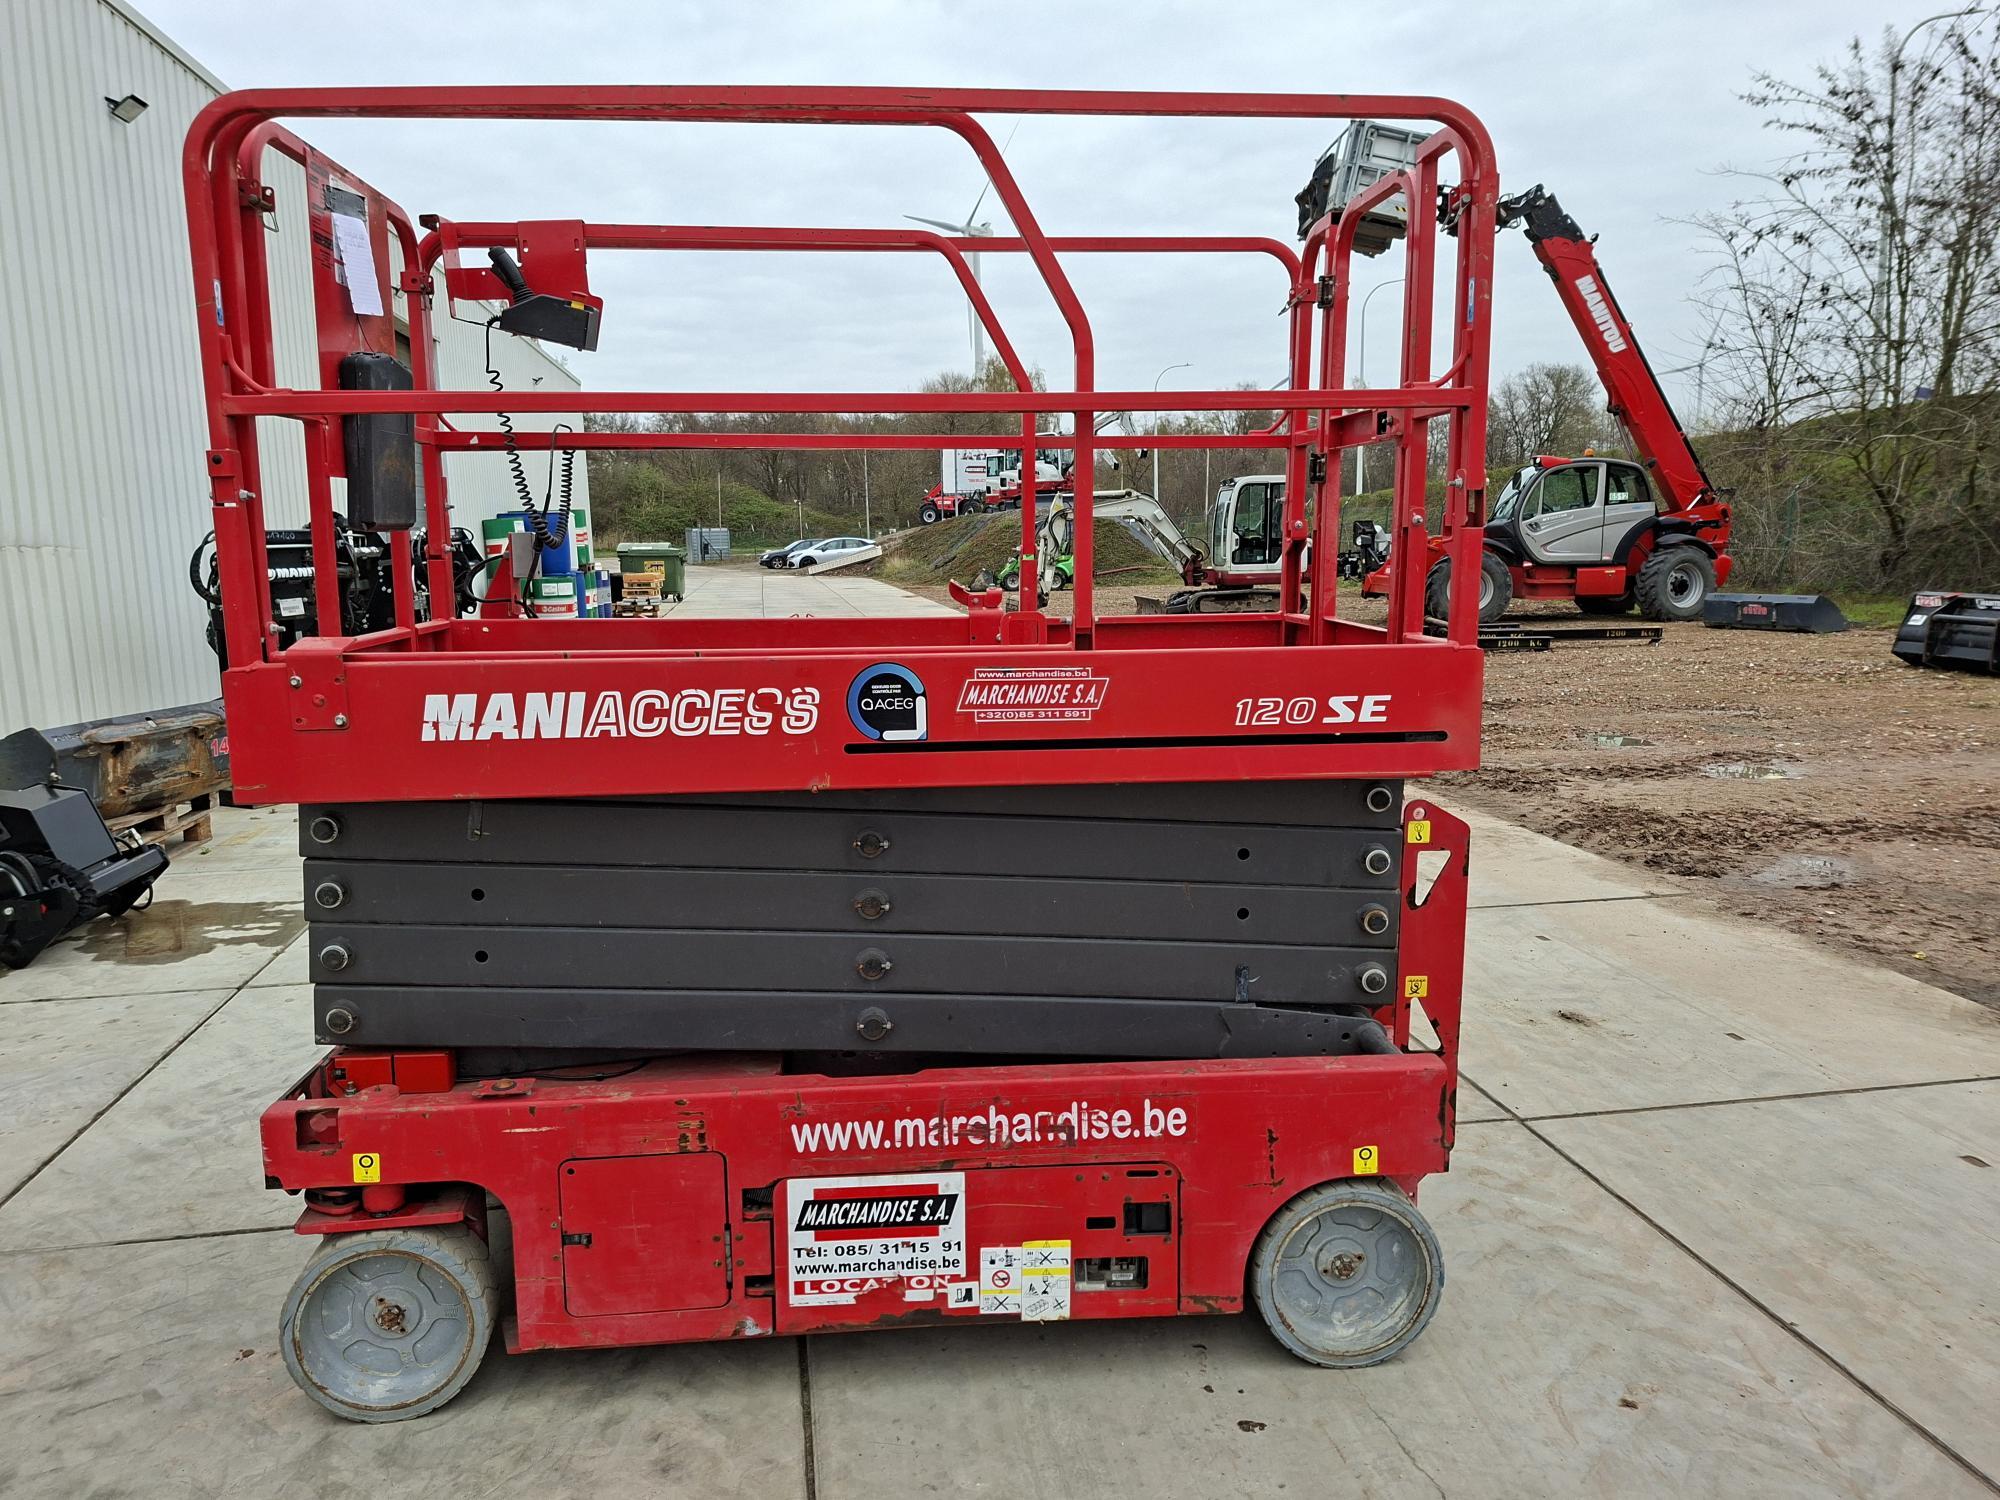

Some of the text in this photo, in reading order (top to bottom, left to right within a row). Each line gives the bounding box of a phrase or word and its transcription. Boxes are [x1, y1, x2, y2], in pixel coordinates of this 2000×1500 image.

[1575, 274, 1628, 353] MANITOU
[978, 669, 1088, 679] www.marchandise.be
[965, 683, 1099, 705] MARCHANDISE S.A.
[421, 687, 820, 742] MANIACCESS
[979, 710, 1087, 720] +32(0)85 311 591
[1235, 695, 1392, 726] 120 SE
[791, 1099, 1187, 1153] www.marchandise.be
[801, 1199, 950, 1226] MARCHANDISE S.A.
[835, 1244, 873, 1257] 085/
[880, 1243, 900, 1255] 31
[941, 1240, 962, 1252] 91
[795, 1255, 961, 1275] www.marchandise.be
[804, 1275, 951, 1294] LOCAON
